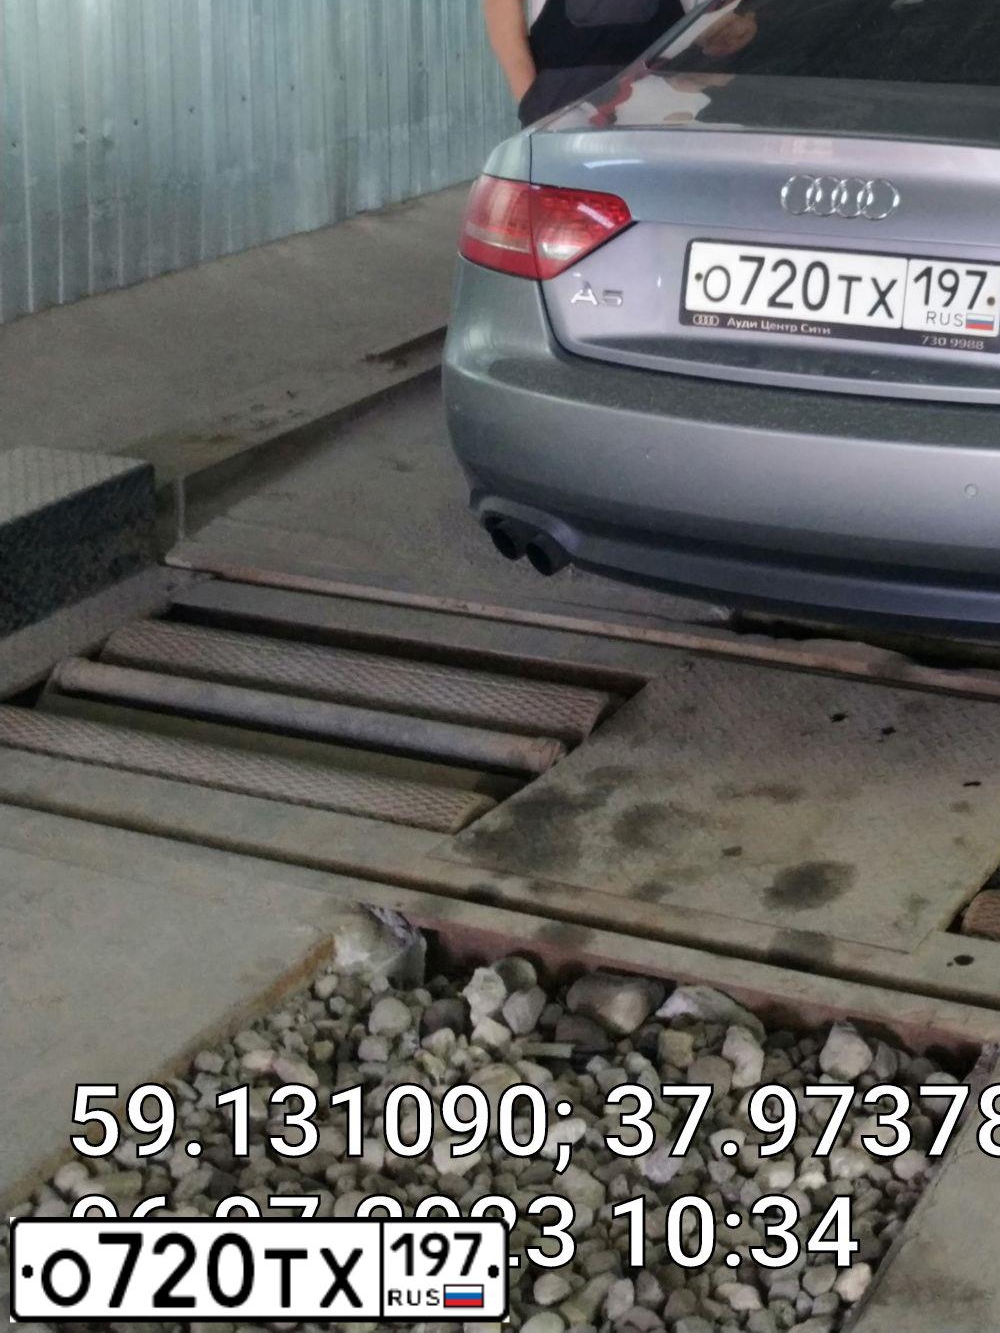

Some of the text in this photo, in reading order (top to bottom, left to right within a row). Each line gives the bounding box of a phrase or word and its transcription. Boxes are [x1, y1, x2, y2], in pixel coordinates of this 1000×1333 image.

[570, 280, 623, 307] A5
[913, 266, 987, 311] 197
[726, 317, 831, 335] Ауди Центр Сити
[926, 311, 963, 327] RUS
[921, 334, 947, 347] 730
